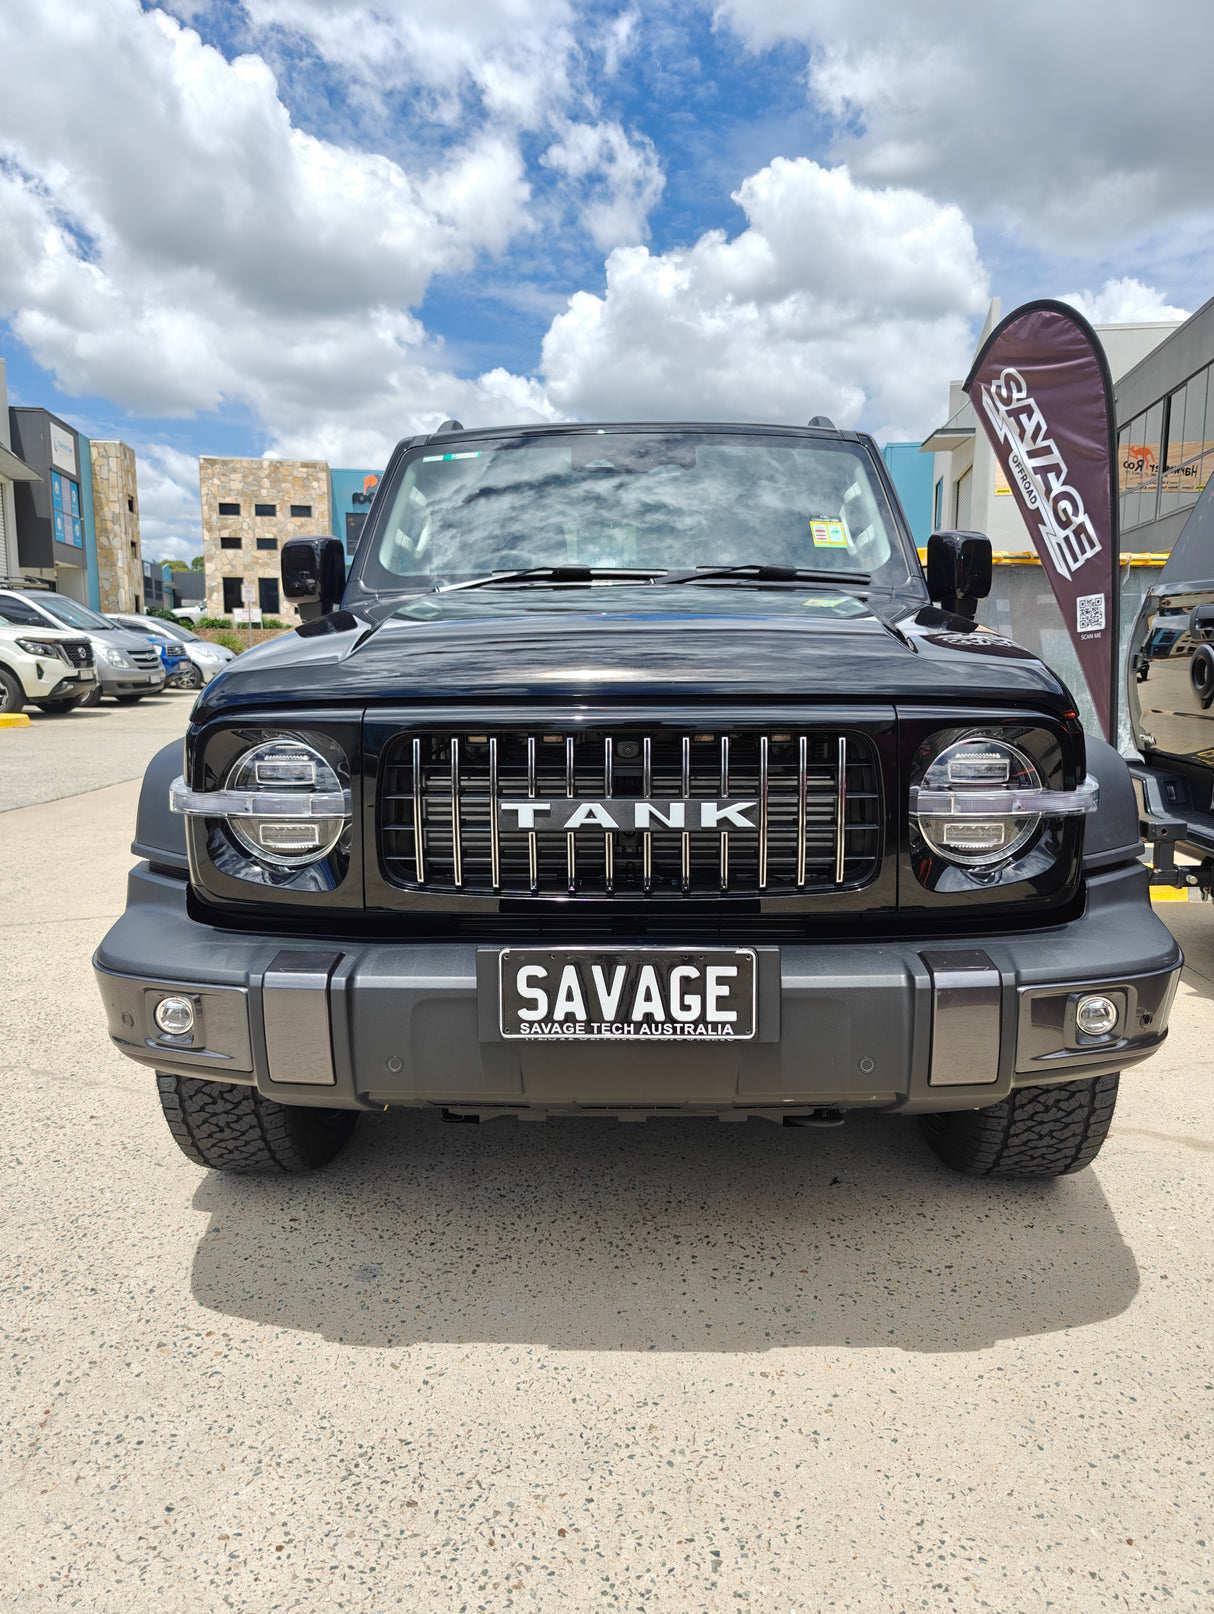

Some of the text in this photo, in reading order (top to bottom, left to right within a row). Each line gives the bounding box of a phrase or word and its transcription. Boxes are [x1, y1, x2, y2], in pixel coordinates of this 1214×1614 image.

[991, 368, 1102, 573] SAVAGE
[1012, 455, 1037, 504] OFFROAD
[500, 802, 757, 829] TANK
[516, 964, 738, 1022] SAVAGE
[519, 1022, 734, 1036] SAVAGE TECH AUSTRALIA
